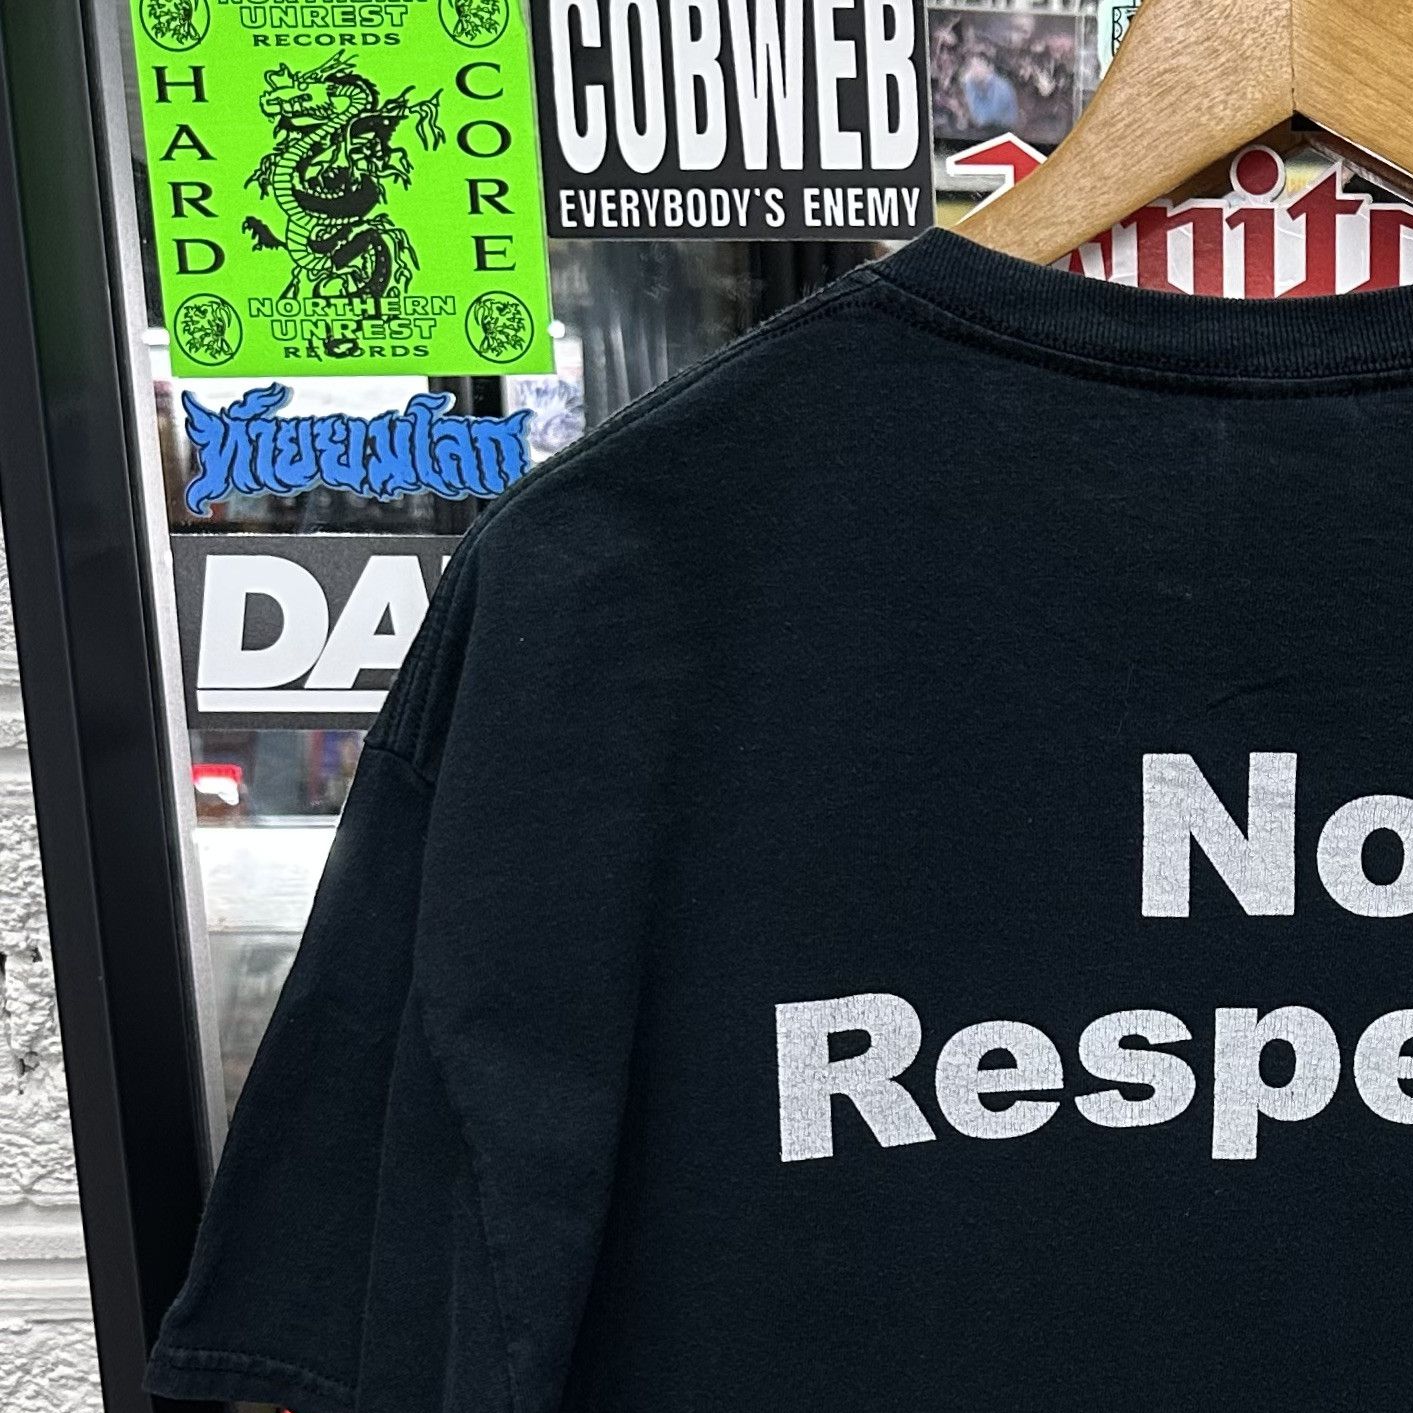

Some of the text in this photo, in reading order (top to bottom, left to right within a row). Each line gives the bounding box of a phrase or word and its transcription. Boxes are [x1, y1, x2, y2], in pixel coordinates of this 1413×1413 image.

[239, 4, 409, 29] UNREST
[252, 32, 401, 47] RECORDS
[549, 0, 921, 174] COBWEB
[151, 64, 226, 276] HARD
[454, 61, 517, 272] CORE
[559, 186, 921, 228] EVERYBODY'S ENEMY
[248, 295, 457, 318] NORTHERN
[271, 317, 437, 341] UNREST
[283, 344, 430, 360] REORDS
[197, 554, 451, 690] DA
